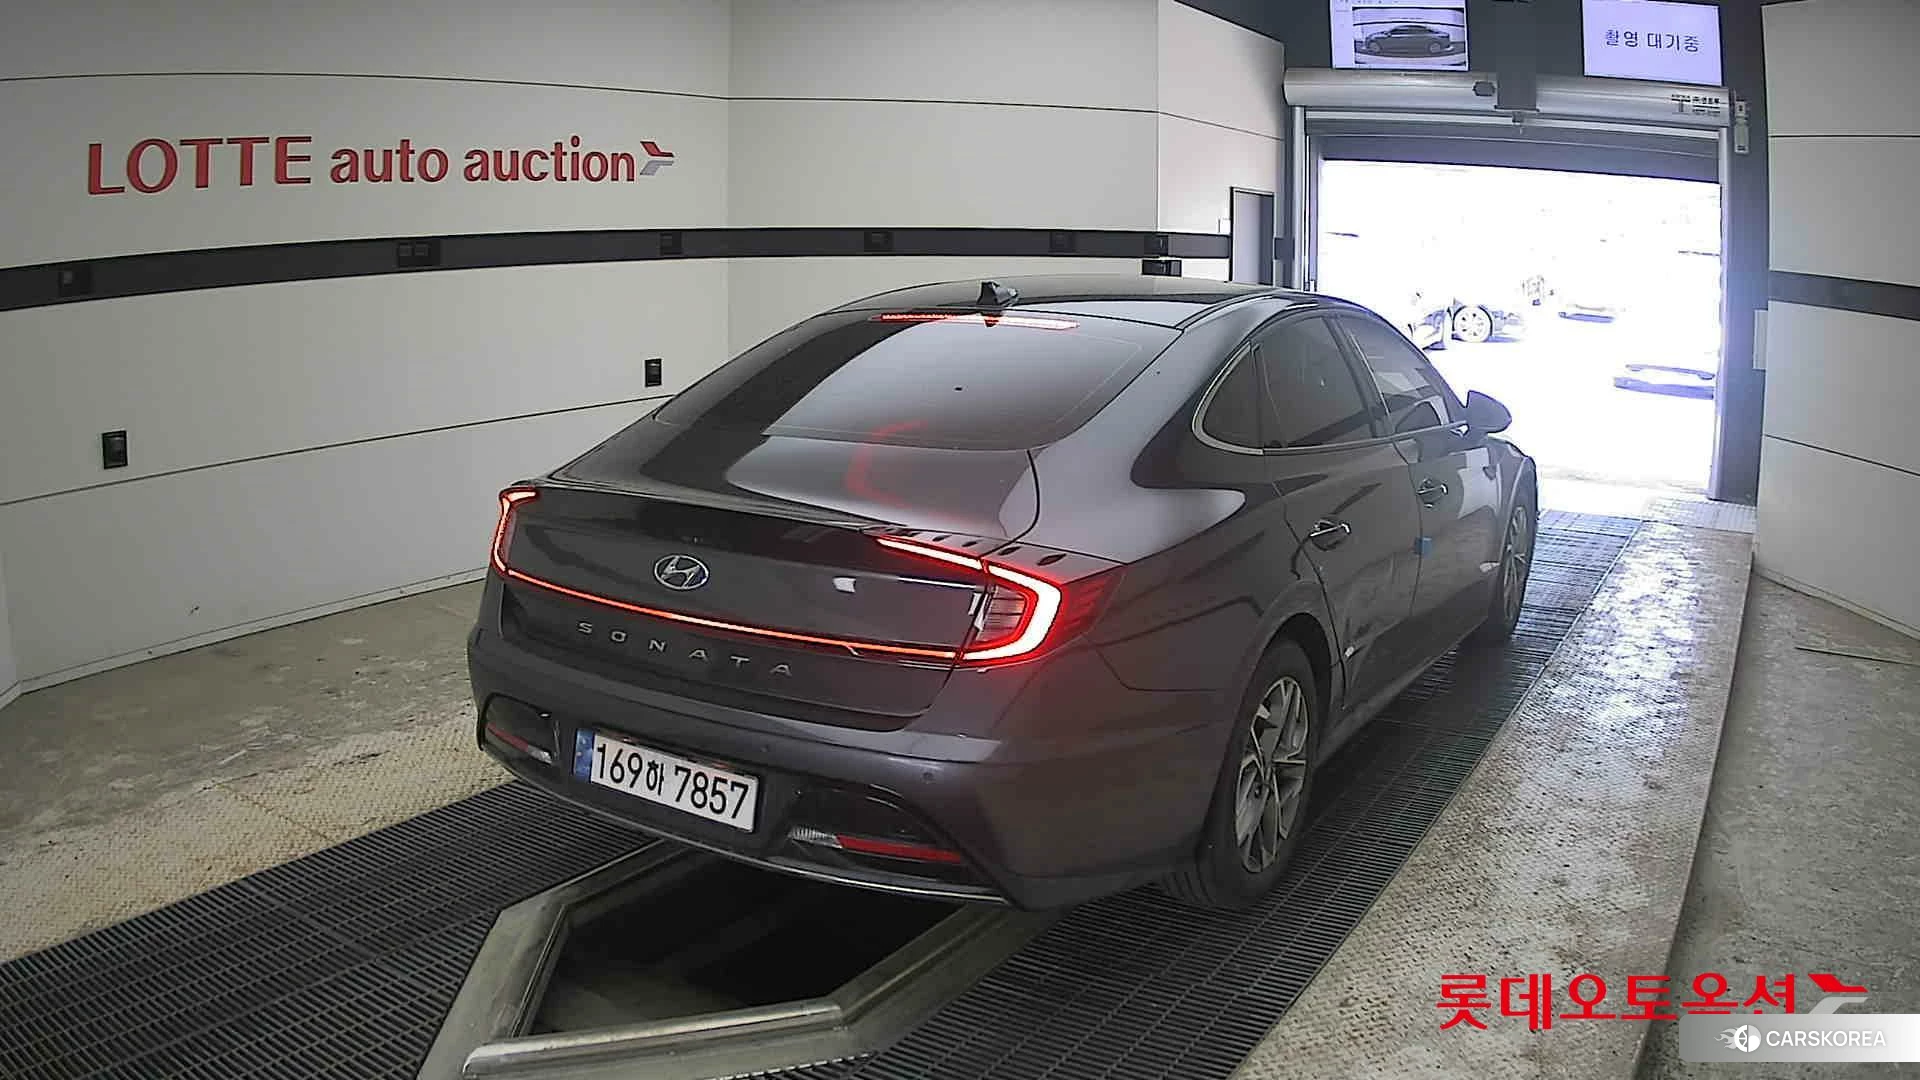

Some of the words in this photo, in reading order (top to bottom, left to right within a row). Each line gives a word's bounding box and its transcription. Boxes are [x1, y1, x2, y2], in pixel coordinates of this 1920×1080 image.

[1605, 29, 1638, 48] 촬영
[1647, 33, 1699, 52] 대기중
[87, 136, 312, 195] LOTTE
[329, 138, 449, 184] auto
[463, 135, 636, 183] auction
[577, 620, 793, 677] SONATA
[596, 743, 665, 797] 169하
[674, 764, 750, 820] 7857
